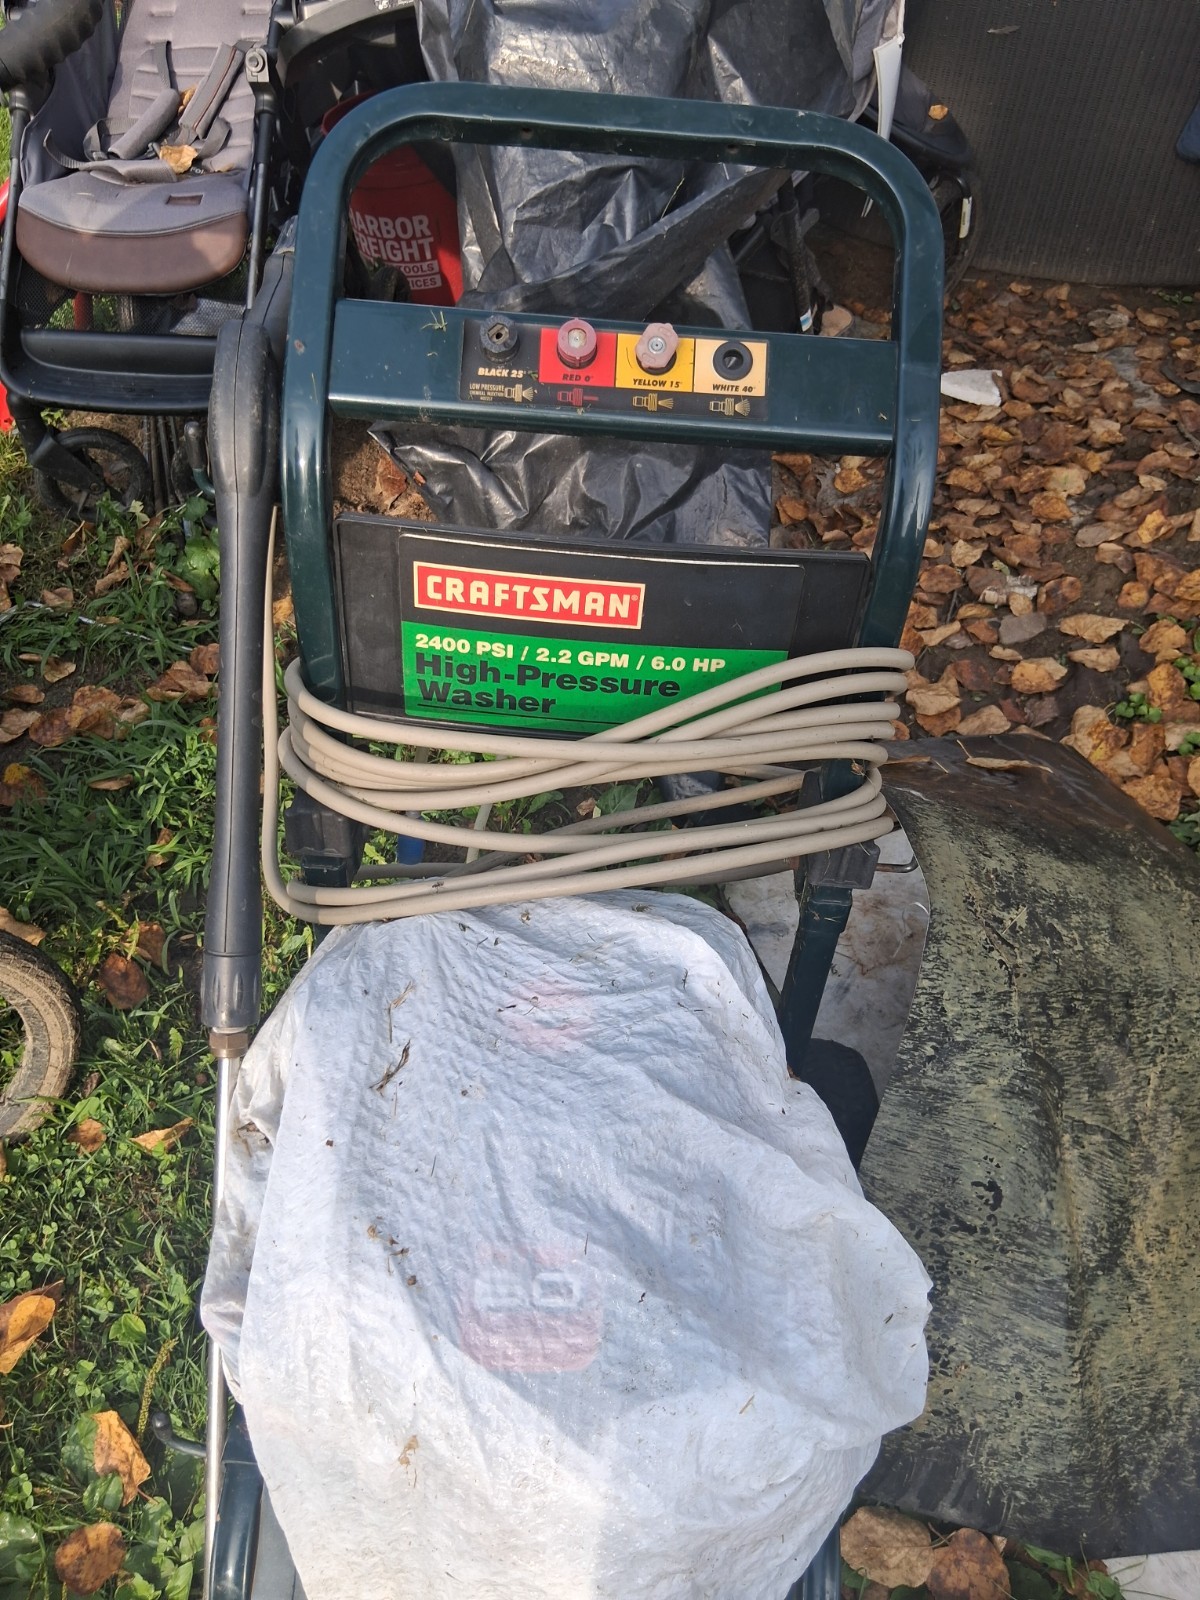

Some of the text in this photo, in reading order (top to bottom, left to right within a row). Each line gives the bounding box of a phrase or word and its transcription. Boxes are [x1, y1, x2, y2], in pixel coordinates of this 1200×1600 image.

[410, 277, 437, 288] ICES
[478, 367, 509, 377] BLACK
[562, 373, 581, 382] RED
[633, 378, 667, 387] YELLOW
[712, 384, 740, 392] WHITE
[415, 633, 726, 672] 2400 PSI / 2.2 GPM / 6.0 HP
[415, 652, 680, 697] High-Pressure
[417, 678, 556, 713] Washer
